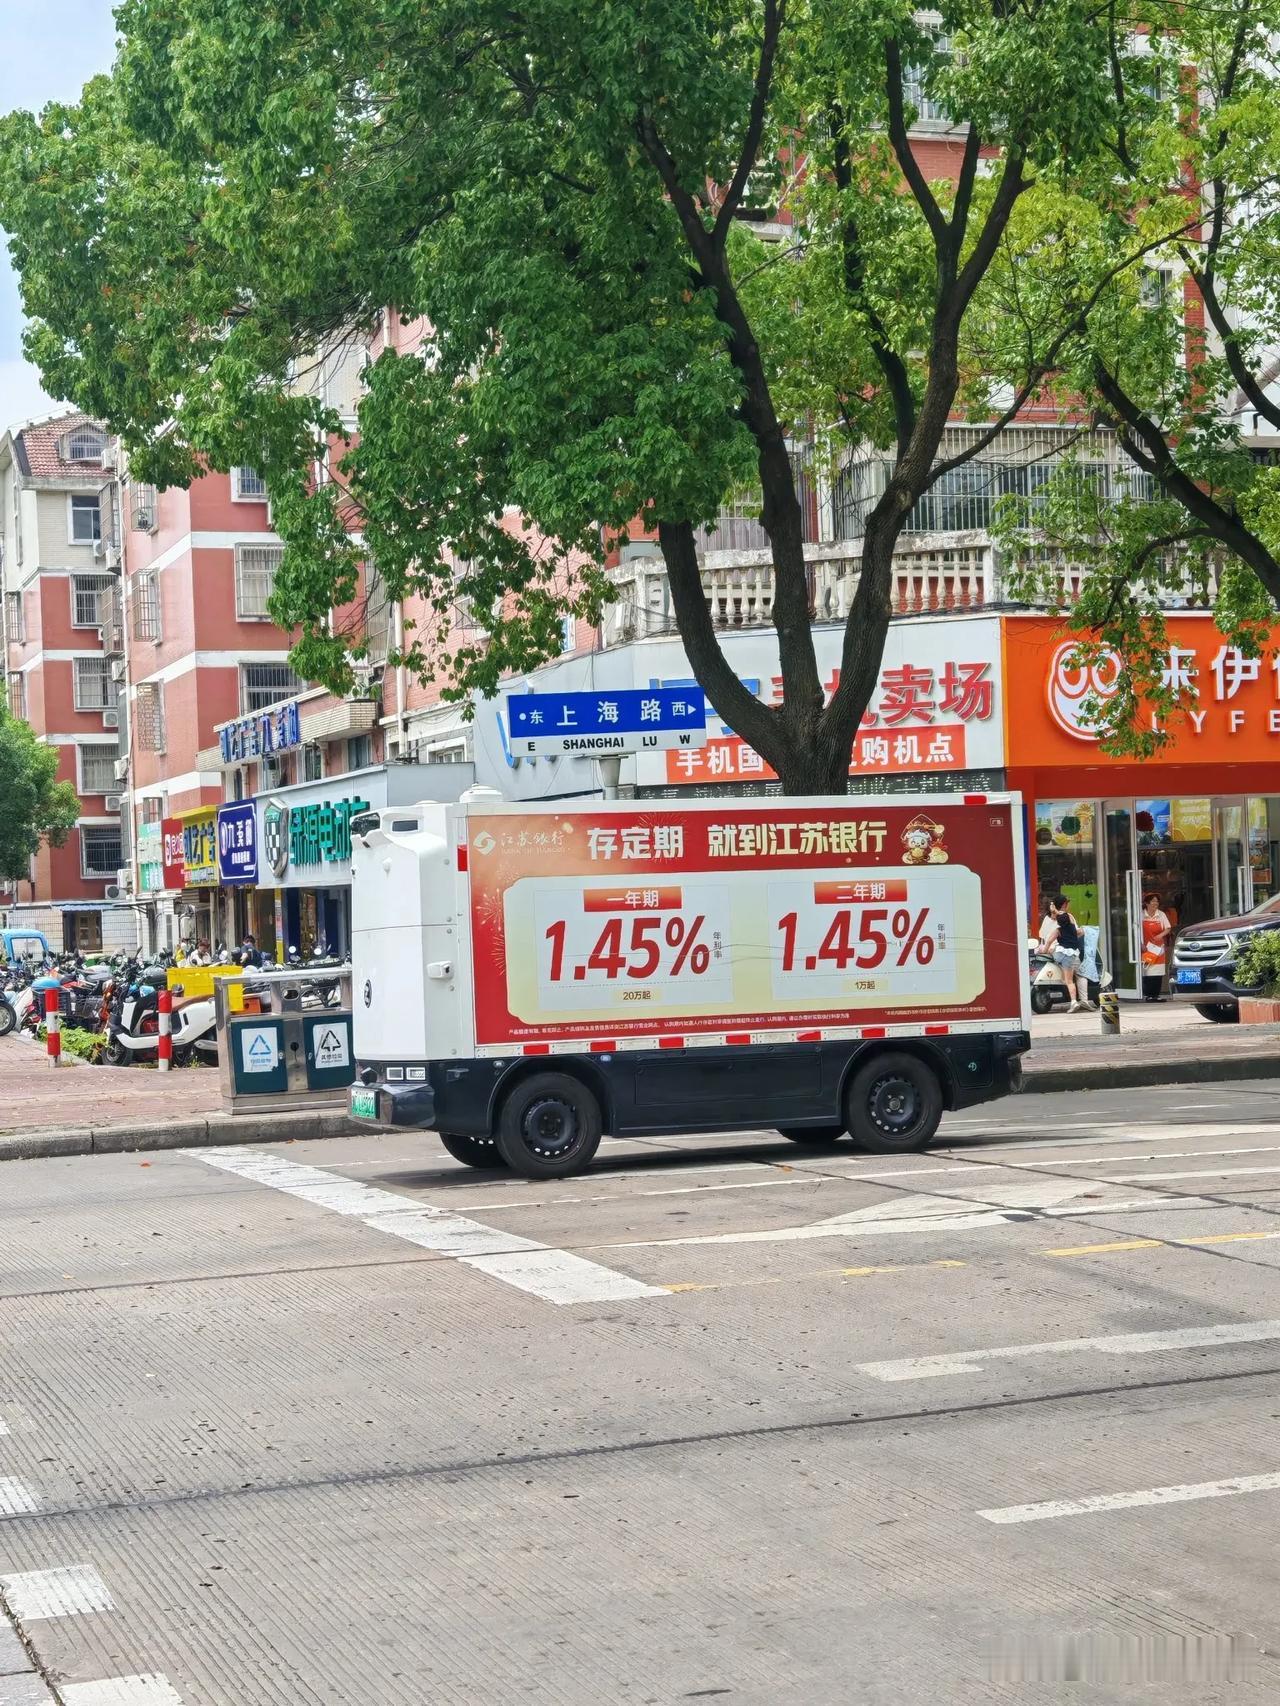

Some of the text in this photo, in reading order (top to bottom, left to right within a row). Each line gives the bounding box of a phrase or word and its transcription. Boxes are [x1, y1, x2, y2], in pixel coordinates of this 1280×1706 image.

[1150, 645, 1280, 700] 来伊
[530, 699, 686, 727] 东 上海路 西
[527, 734, 691, 752] E SHANGHAI LU W
[587, 821, 888, 860] 存定期 就到江苏银行
[607, 890, 659, 908] 一年期
[837, 883, 885, 900] 二年期
[545, 915, 710, 981] 1.45%
[778, 907, 935, 971] 1.45%
[623, 990, 651, 1001] 20万起
[855, 980, 876, 990] 1万起
